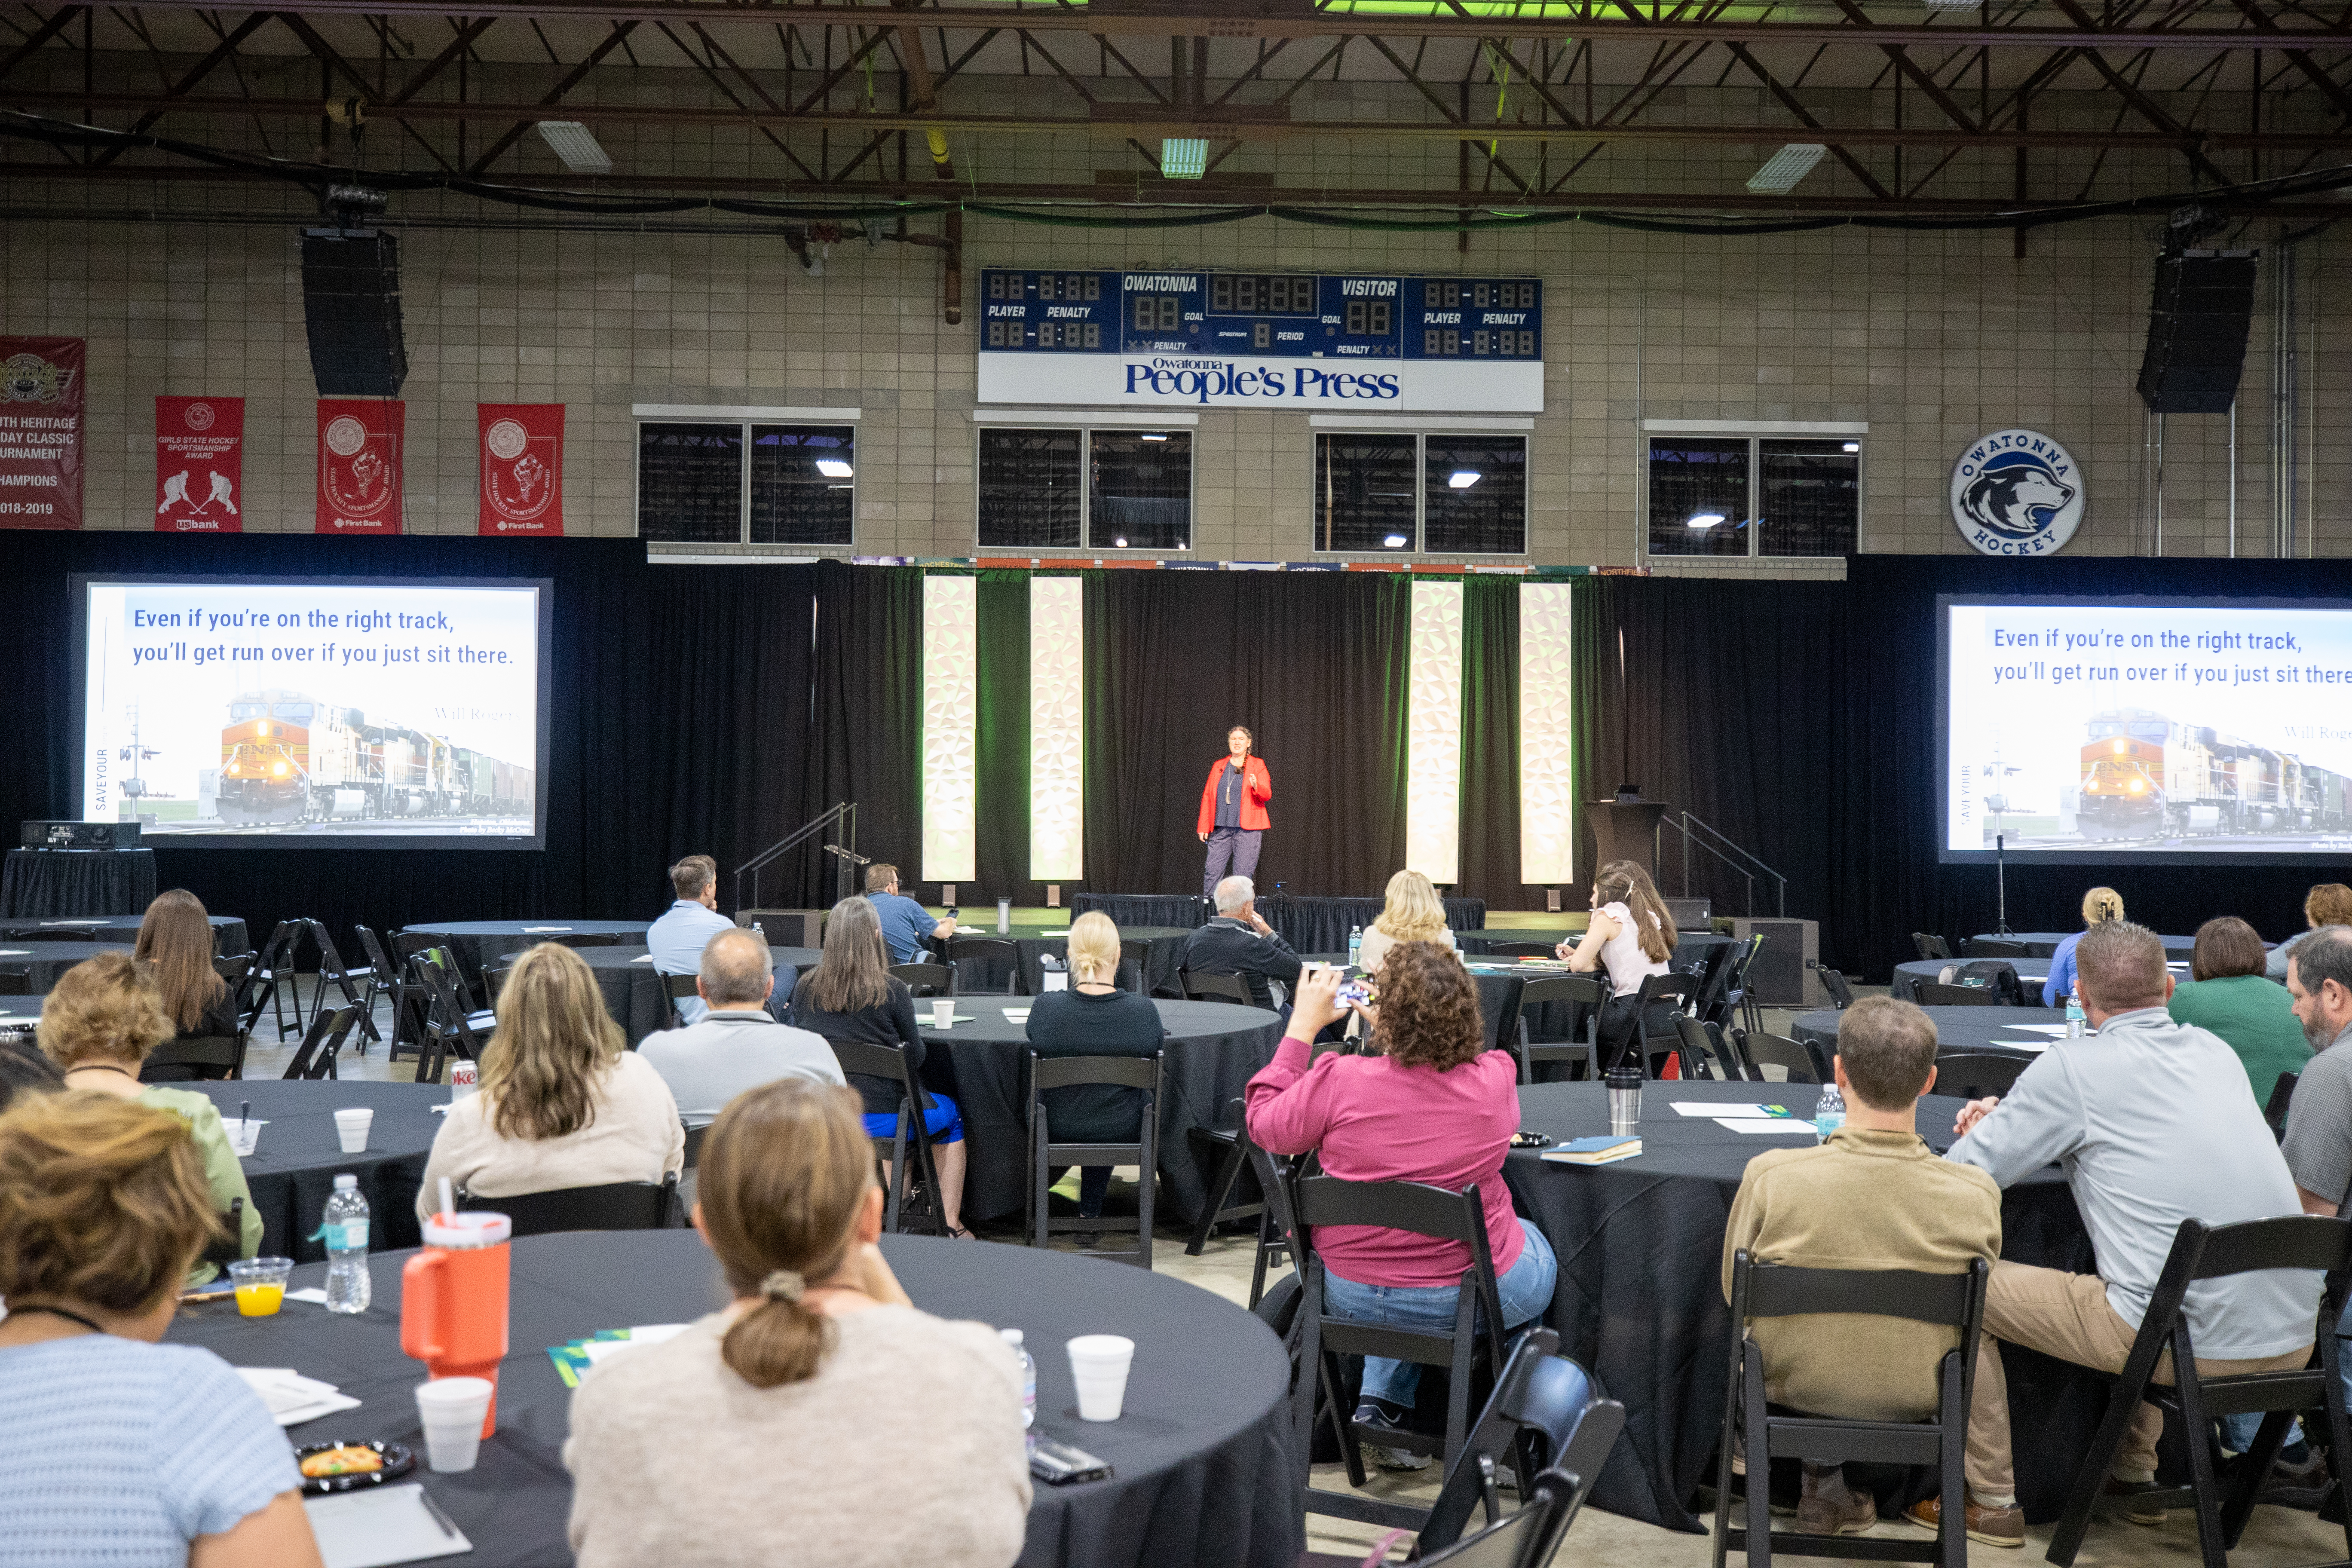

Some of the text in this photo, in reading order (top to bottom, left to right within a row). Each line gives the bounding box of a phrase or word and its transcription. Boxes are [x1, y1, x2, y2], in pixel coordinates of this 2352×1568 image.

[1124, 275, 1197, 292] OWATONNA
[1342, 280, 1397, 297] VISITOR
[989, 306, 1090, 318] PLAYER PENALTY
[1184, 312, 1204, 321] GOAL
[1424, 312, 1526, 325] PLAYER PENALTY
[1322, 315, 1341, 325] GOAL
[1277, 332, 1304, 341] PERIOD
[1154, 341, 1187, 351] PENALTY
[1337, 345, 1370, 355] PENALTY
[1152, 357, 1222, 370] Owatonna
[1124, 364, 1400, 404] People's Press
[21, 417, 76, 429] HERITAGE
[27, 433, 74, 444] CLASSIC
[1962, 435, 2069, 478] OWATONNA
[331, 486, 346, 507] HOCKEY
[347, 487, 388, 511] SPORTSMANSHIP
[493, 490, 509, 511] HOCKEY
[509, 490, 549, 516] SPORTSMANSHIP
[1973, 530, 2056, 555] HOCKEY
[135, 608, 453, 633] Even if you're on the right track,
[1994, 628, 2302, 654] Even if you're on the right track,
[133, 642, 513, 667] you'll get run over if you just sit there.
[1994, 661, 2352, 687] you'll get run over if you just sit there
[435, 707, 521, 723] Will Rogers
[2284, 726, 2313, 738] Will
[478, 826, 486, 834] by
[487, 827, 505, 835] Becky
[505, 827, 530, 835] McCray
